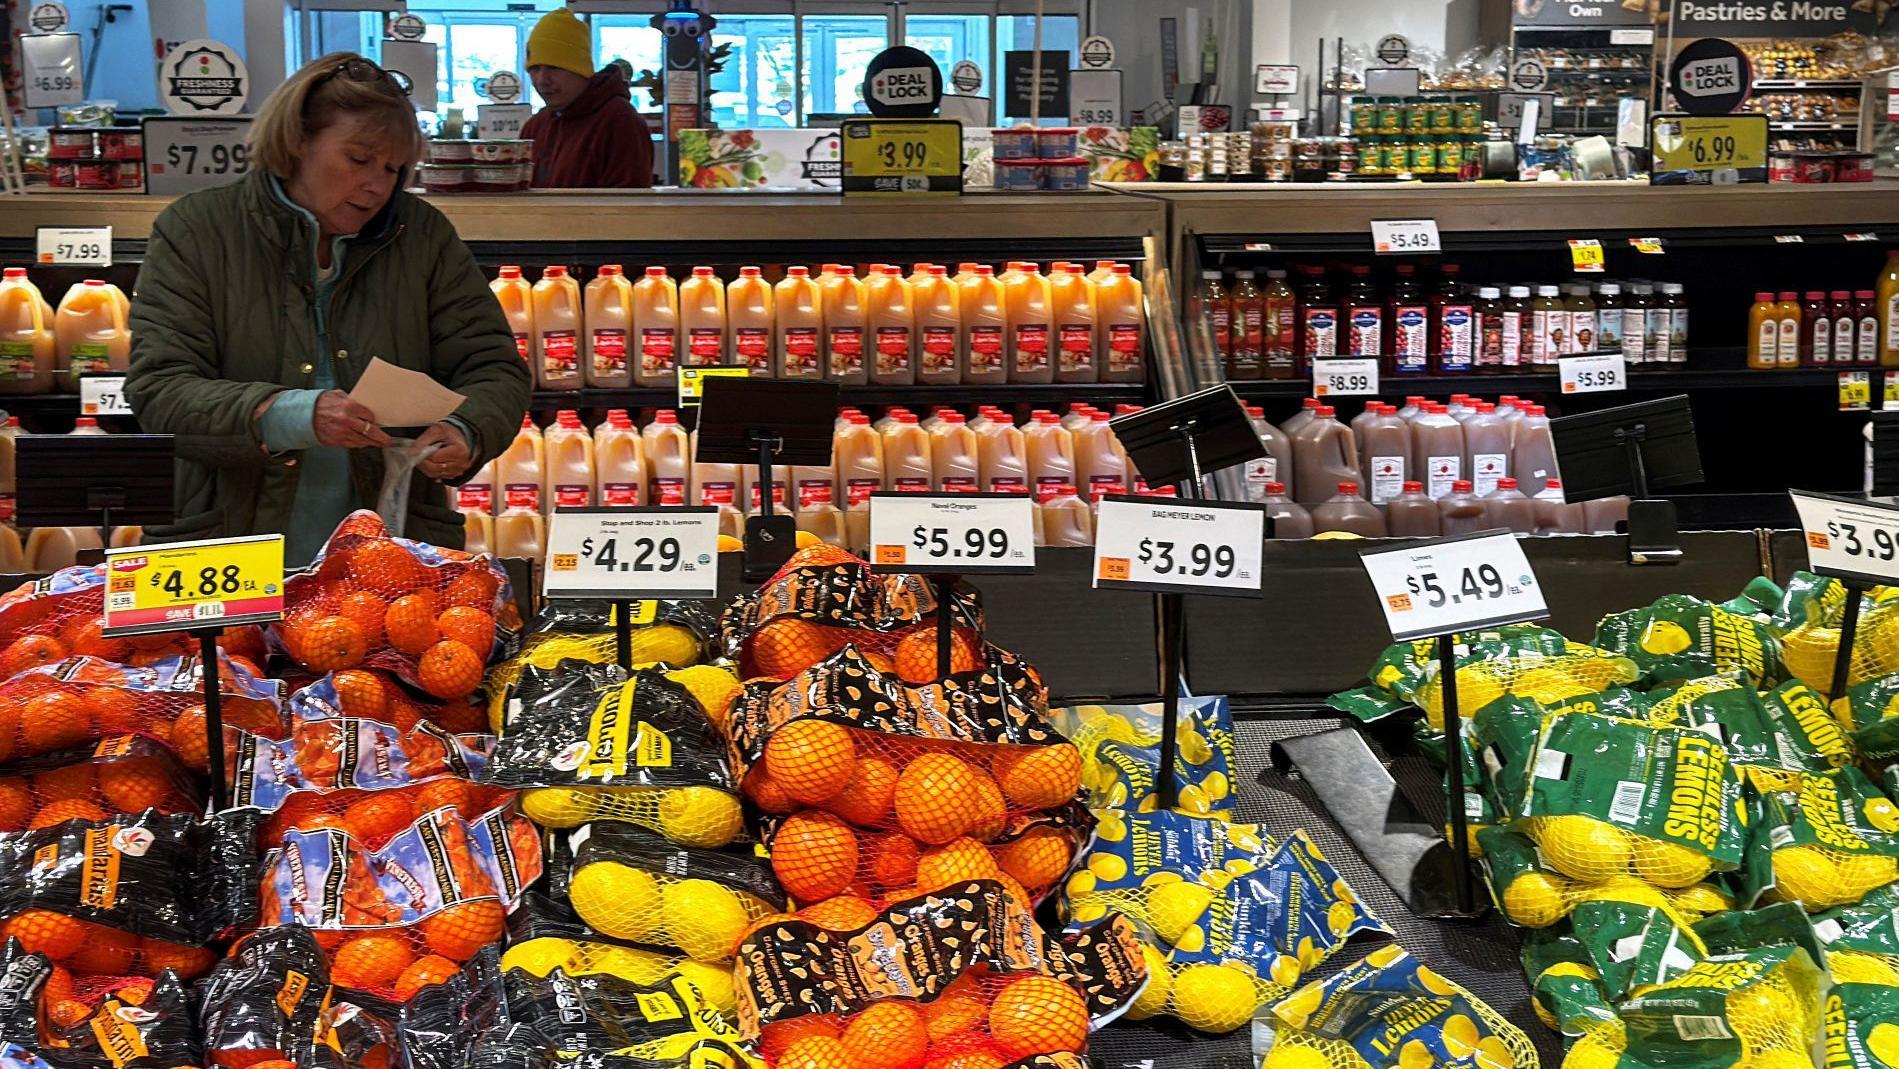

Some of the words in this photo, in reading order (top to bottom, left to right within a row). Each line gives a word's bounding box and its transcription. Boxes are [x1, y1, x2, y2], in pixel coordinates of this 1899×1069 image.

[1569, 4, 1603, 17] Own
[1681, 2, 1766, 21] Pastries
[1771, 3, 1788, 20] &
[1791, 3, 1847, 21] More
[888, 74, 927, 87] DEAL
[1696, 64, 1733, 77] DEAL
[1696, 76, 1735, 89] LOCK
[35, 76, 73, 92] $6.99
[176, 79, 236, 90] FRESHNESS
[888, 86, 928, 99] LOCK
[1079, 110, 1113, 123] $8.99
[167, 142, 249, 175] $7.99
[877, 142, 927, 169] $3.99
[1688, 136, 1735, 161] $6.99
[57, 243, 101, 259] $7.99
[1391, 233, 1430, 248] $5.49
[1330, 375, 1369, 391] $8.99
[1577, 370, 1616, 386] $5.99
[950, 503, 977, 512] Oranges
[1152, 510, 1167, 518] BAG
[1167, 511, 1190, 520] MEYER
[1190, 513, 1216, 522] LEMON
[601, 520, 617, 528] Stop
[635, 520, 654, 528] Shop
[913, 525, 1008, 558] $5.99
[113, 557, 147, 569] SALE
[581, 537, 681, 573] $4.29
[1137, 537, 1235, 579] $3.99
[150, 565, 241, 598] $4.88
[1406, 563, 1504, 608] $5.49
[165, 609, 191, 620] SAVE
[1664, 736, 1711, 841] LEMONS
[1700, 745, 1728, 850] SEEDLESS
[1131, 814, 1149, 877] Lemons
[1147, 831, 1162, 868] MEYER
[1165, 830, 1181, 865] Sunkist
[904, 924, 930, 977] Oranges
[750, 950, 779, 1004] Oranges
[831, 948, 857, 1000] Oranges
[781, 978, 795, 1006] SWEET
[1384, 997, 1430, 1025] MEYER
[1370, 998, 1453, 1056] Lemons
